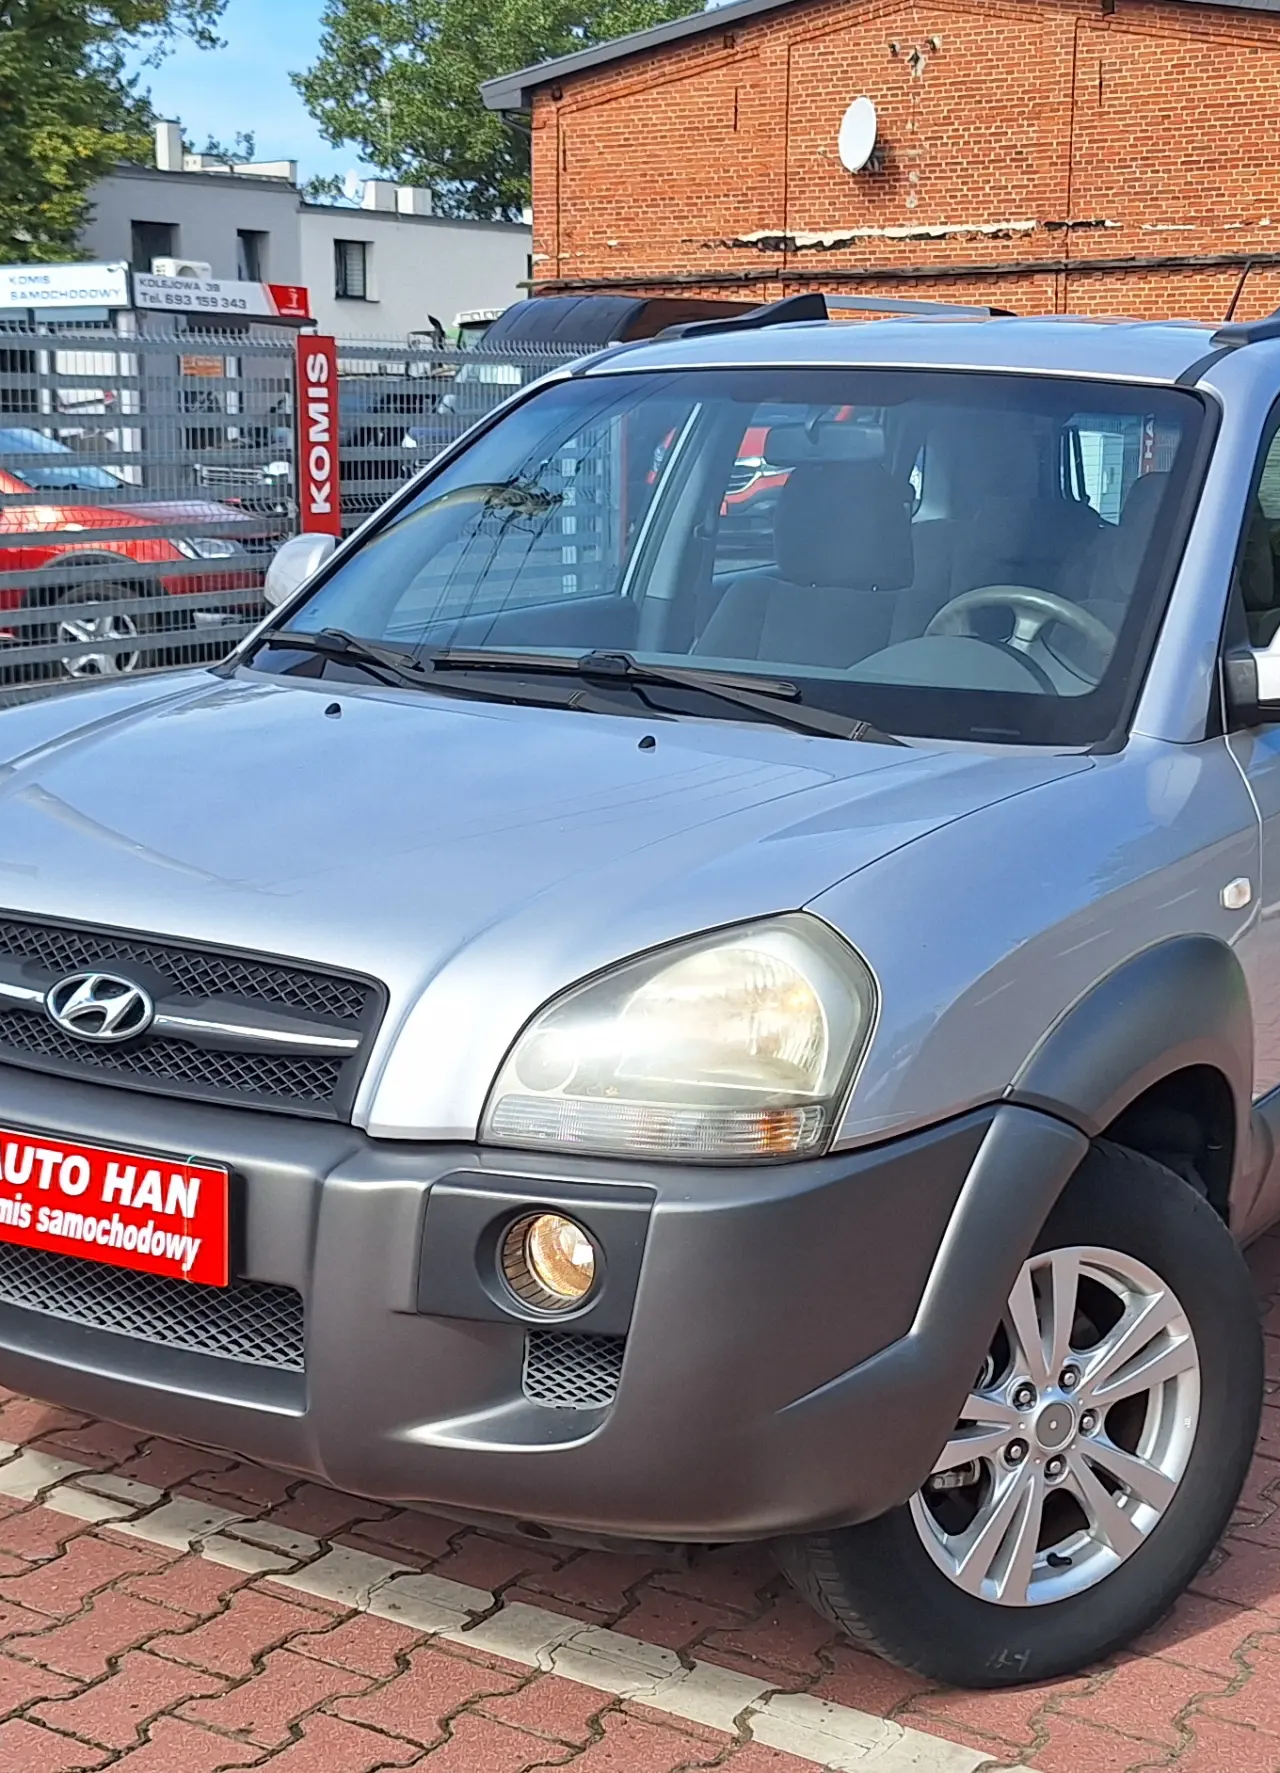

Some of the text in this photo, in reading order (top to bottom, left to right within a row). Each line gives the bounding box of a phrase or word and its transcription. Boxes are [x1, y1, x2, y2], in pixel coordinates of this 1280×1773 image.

[8, 275, 51, 285] KOMIS
[140, 279, 201, 291] KOLEJOWA
[10, 288, 121, 301] SAMOCHODOWY
[165, 294, 192, 306] 693
[196, 296, 218, 308] 159
[221, 298, 247, 310] 343
[306, 352, 331, 514] KOMIS
[101, 1162, 202, 1219] HAN
[35, 1206, 202, 1272] samochodowy
